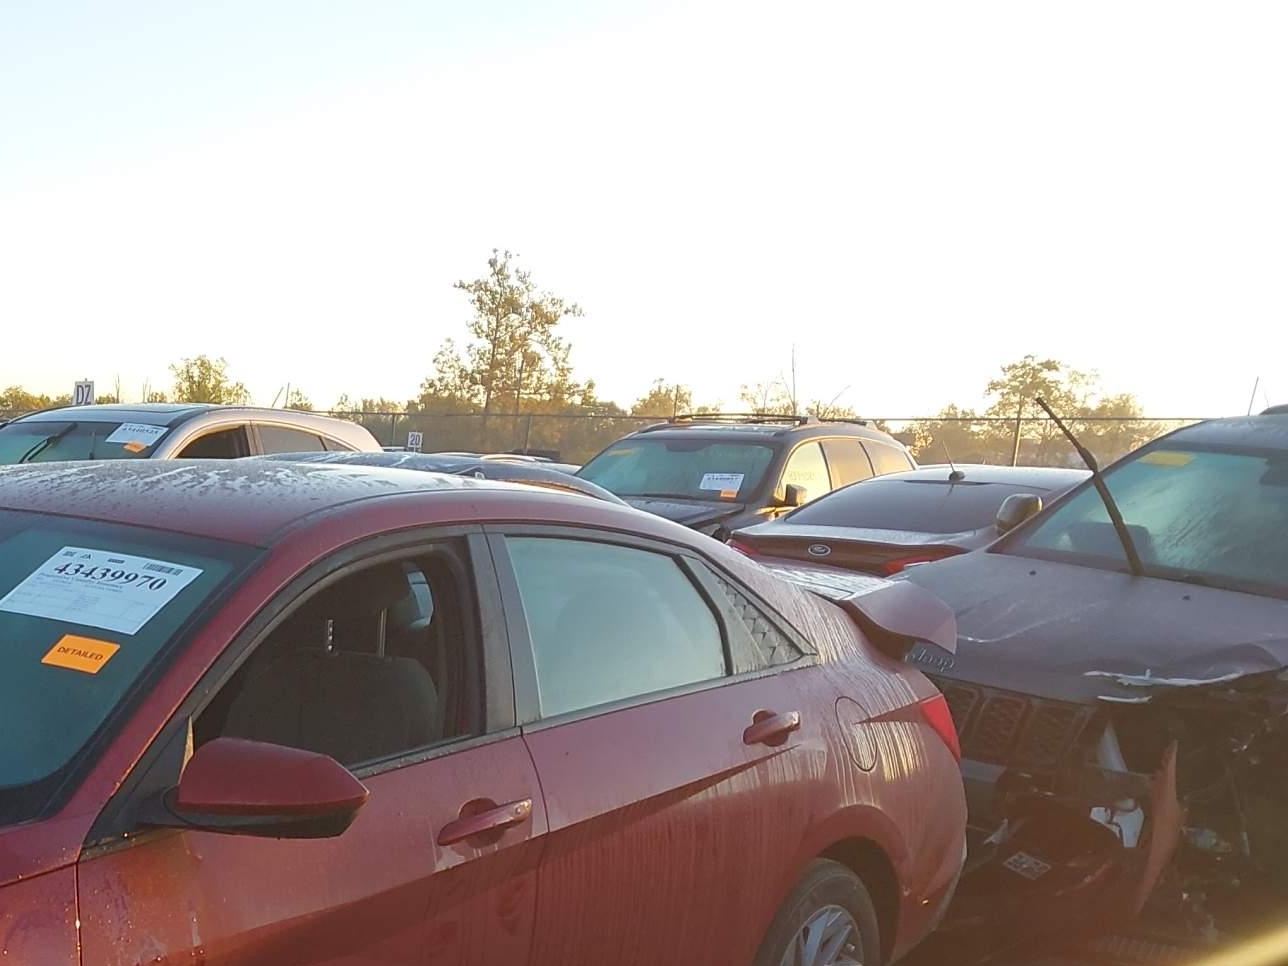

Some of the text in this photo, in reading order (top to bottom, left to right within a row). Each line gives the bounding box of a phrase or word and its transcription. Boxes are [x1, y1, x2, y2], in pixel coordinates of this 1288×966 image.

[410, 434, 421, 446] 20
[54, 562, 168, 591] 43439970
[57, 646, 104, 661] DETAILED
